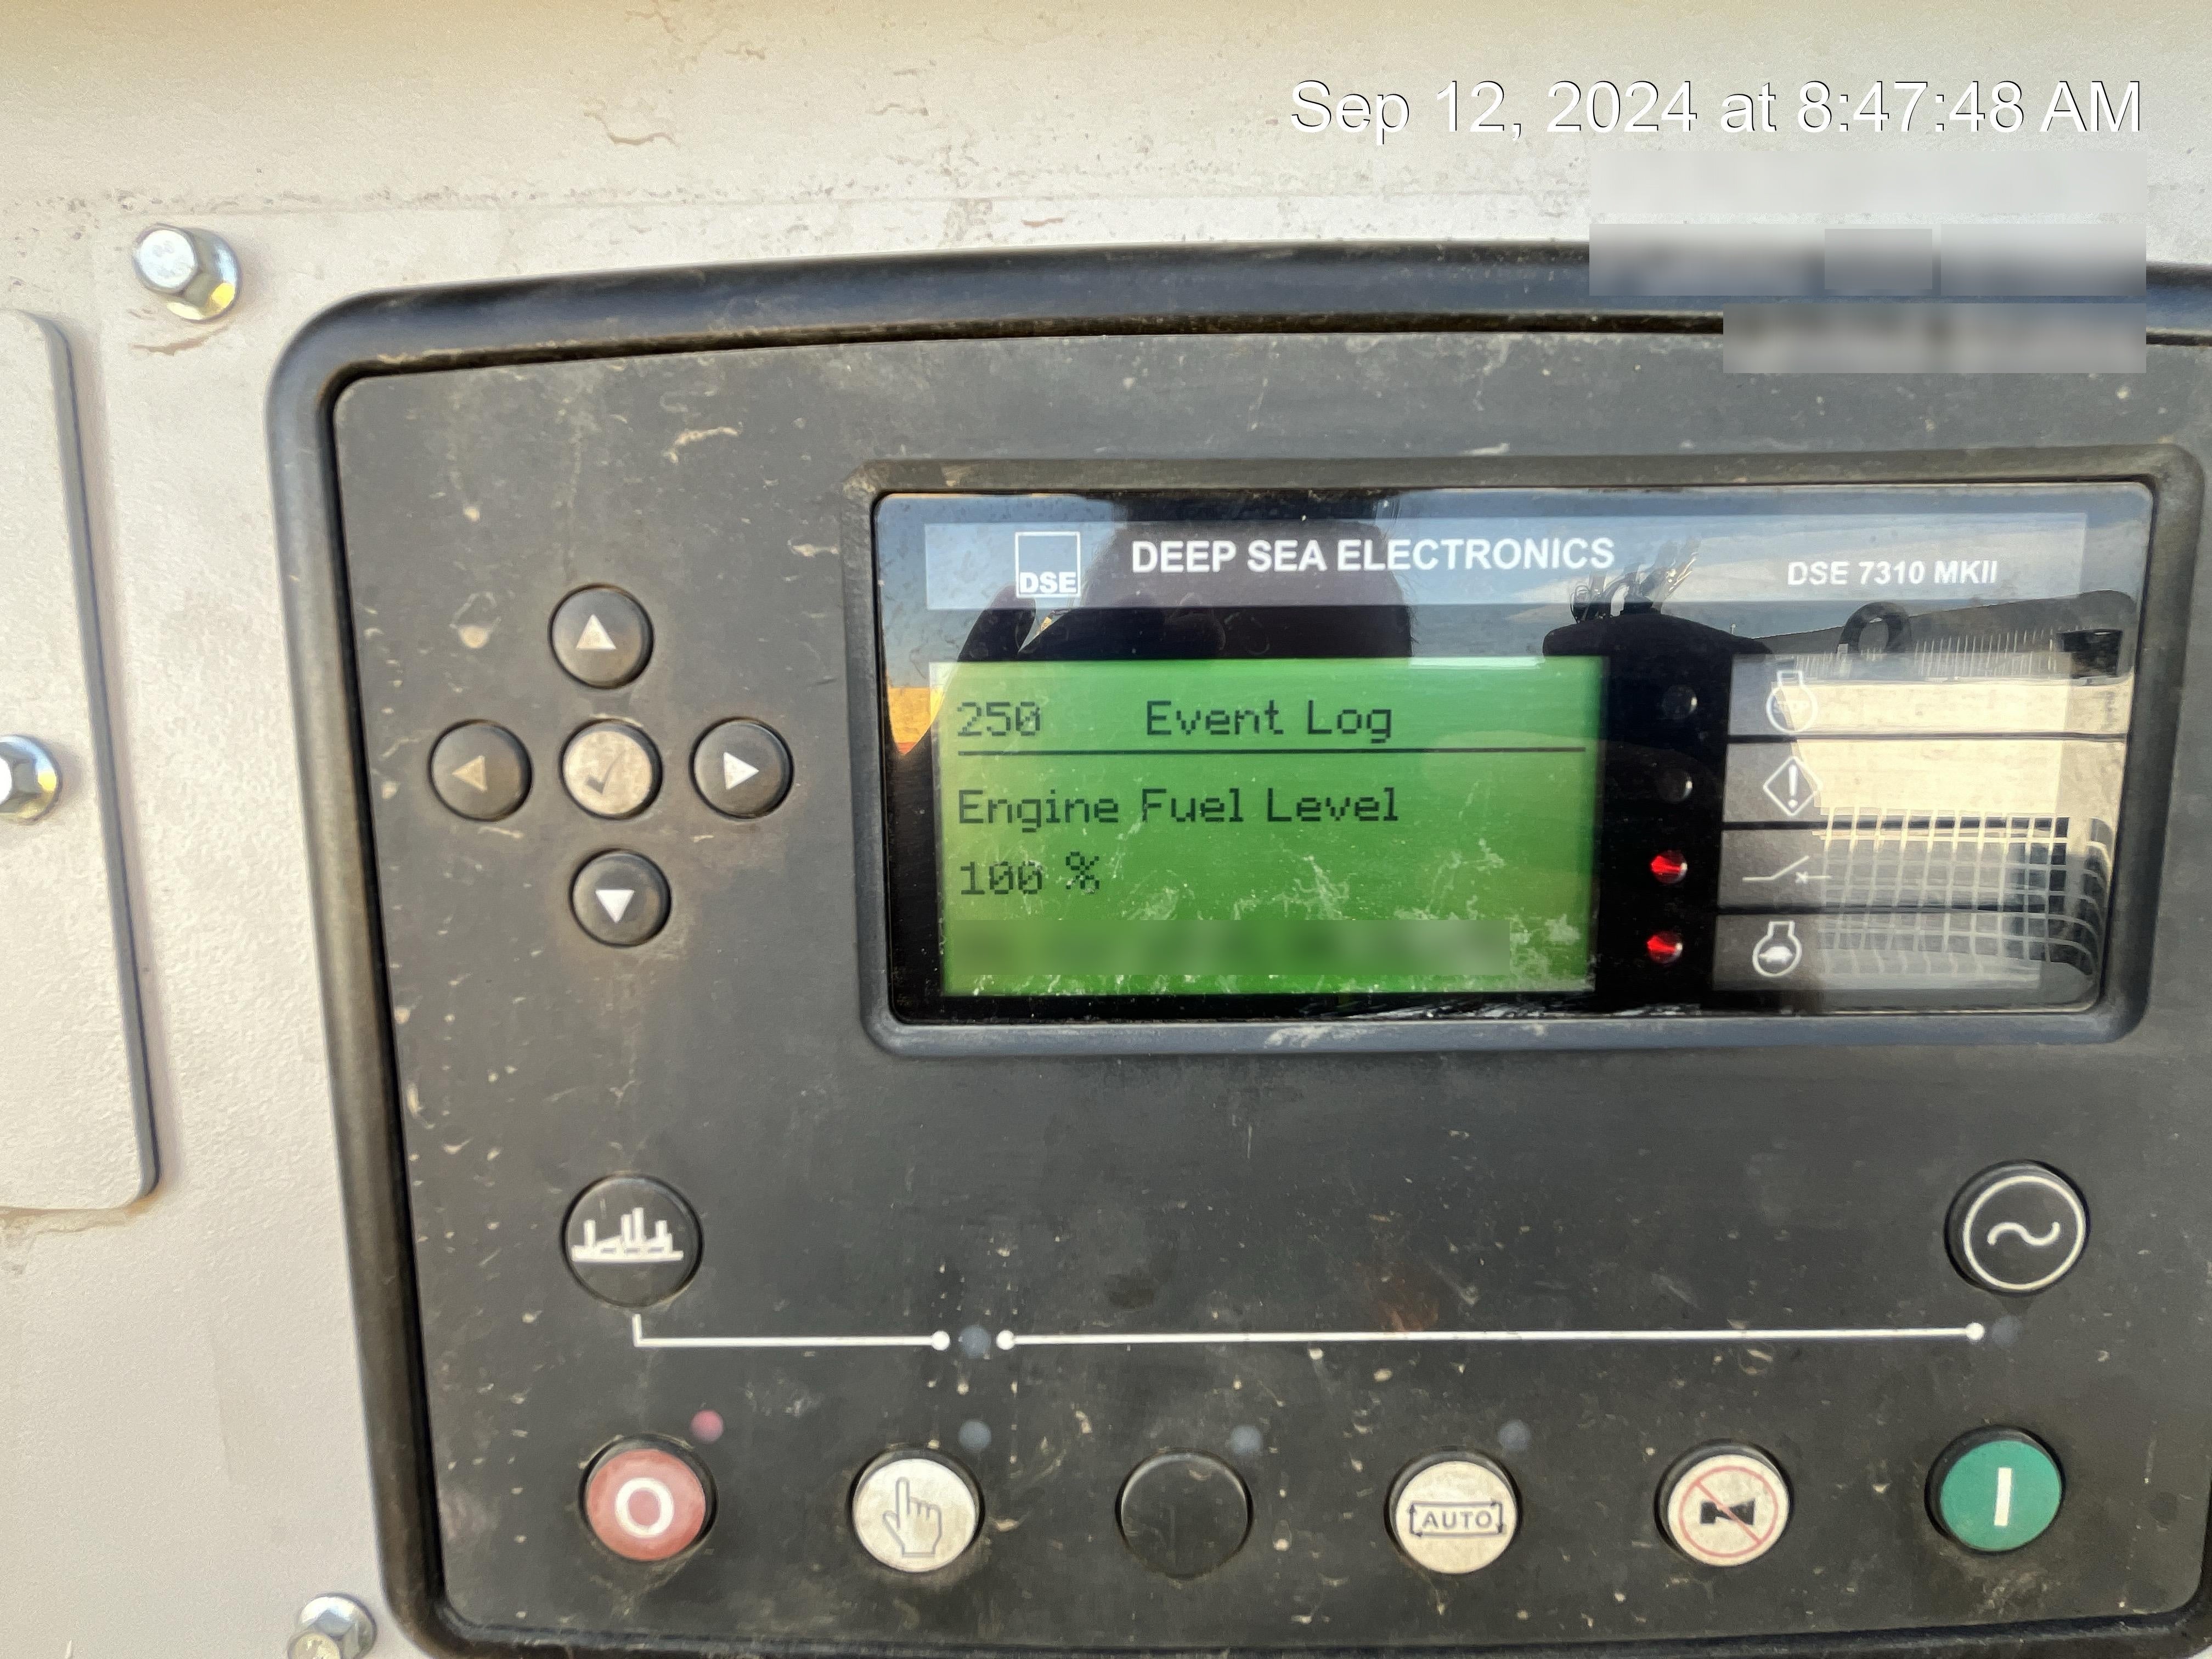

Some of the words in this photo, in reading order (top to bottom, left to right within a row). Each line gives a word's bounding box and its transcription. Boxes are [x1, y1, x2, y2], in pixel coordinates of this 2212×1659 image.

[1131, 540, 1237, 573] DEEP
[1246, 539, 1328, 572] SEA
[1336, 537, 1616, 572] ELECTRONICS
[1787, 561, 1850, 585] DSE
[1858, 561, 1926, 585] 7310
[1933, 560, 1998, 584] MKII
[1018, 571, 1077, 595] DSE
[956, 701, 1040, 737] 250
[1146, 699, 1284, 736] Event
[1307, 699, 1392, 743] Log
[958, 788, 1120, 833] Engine
[1141, 787, 1244, 823] Fuel
[1267, 787, 1400, 822] Level
[960, 861, 1044, 896] 100
[1064, 850, 1101, 894] %
[1421, 1510, 1493, 1530] AUTO
